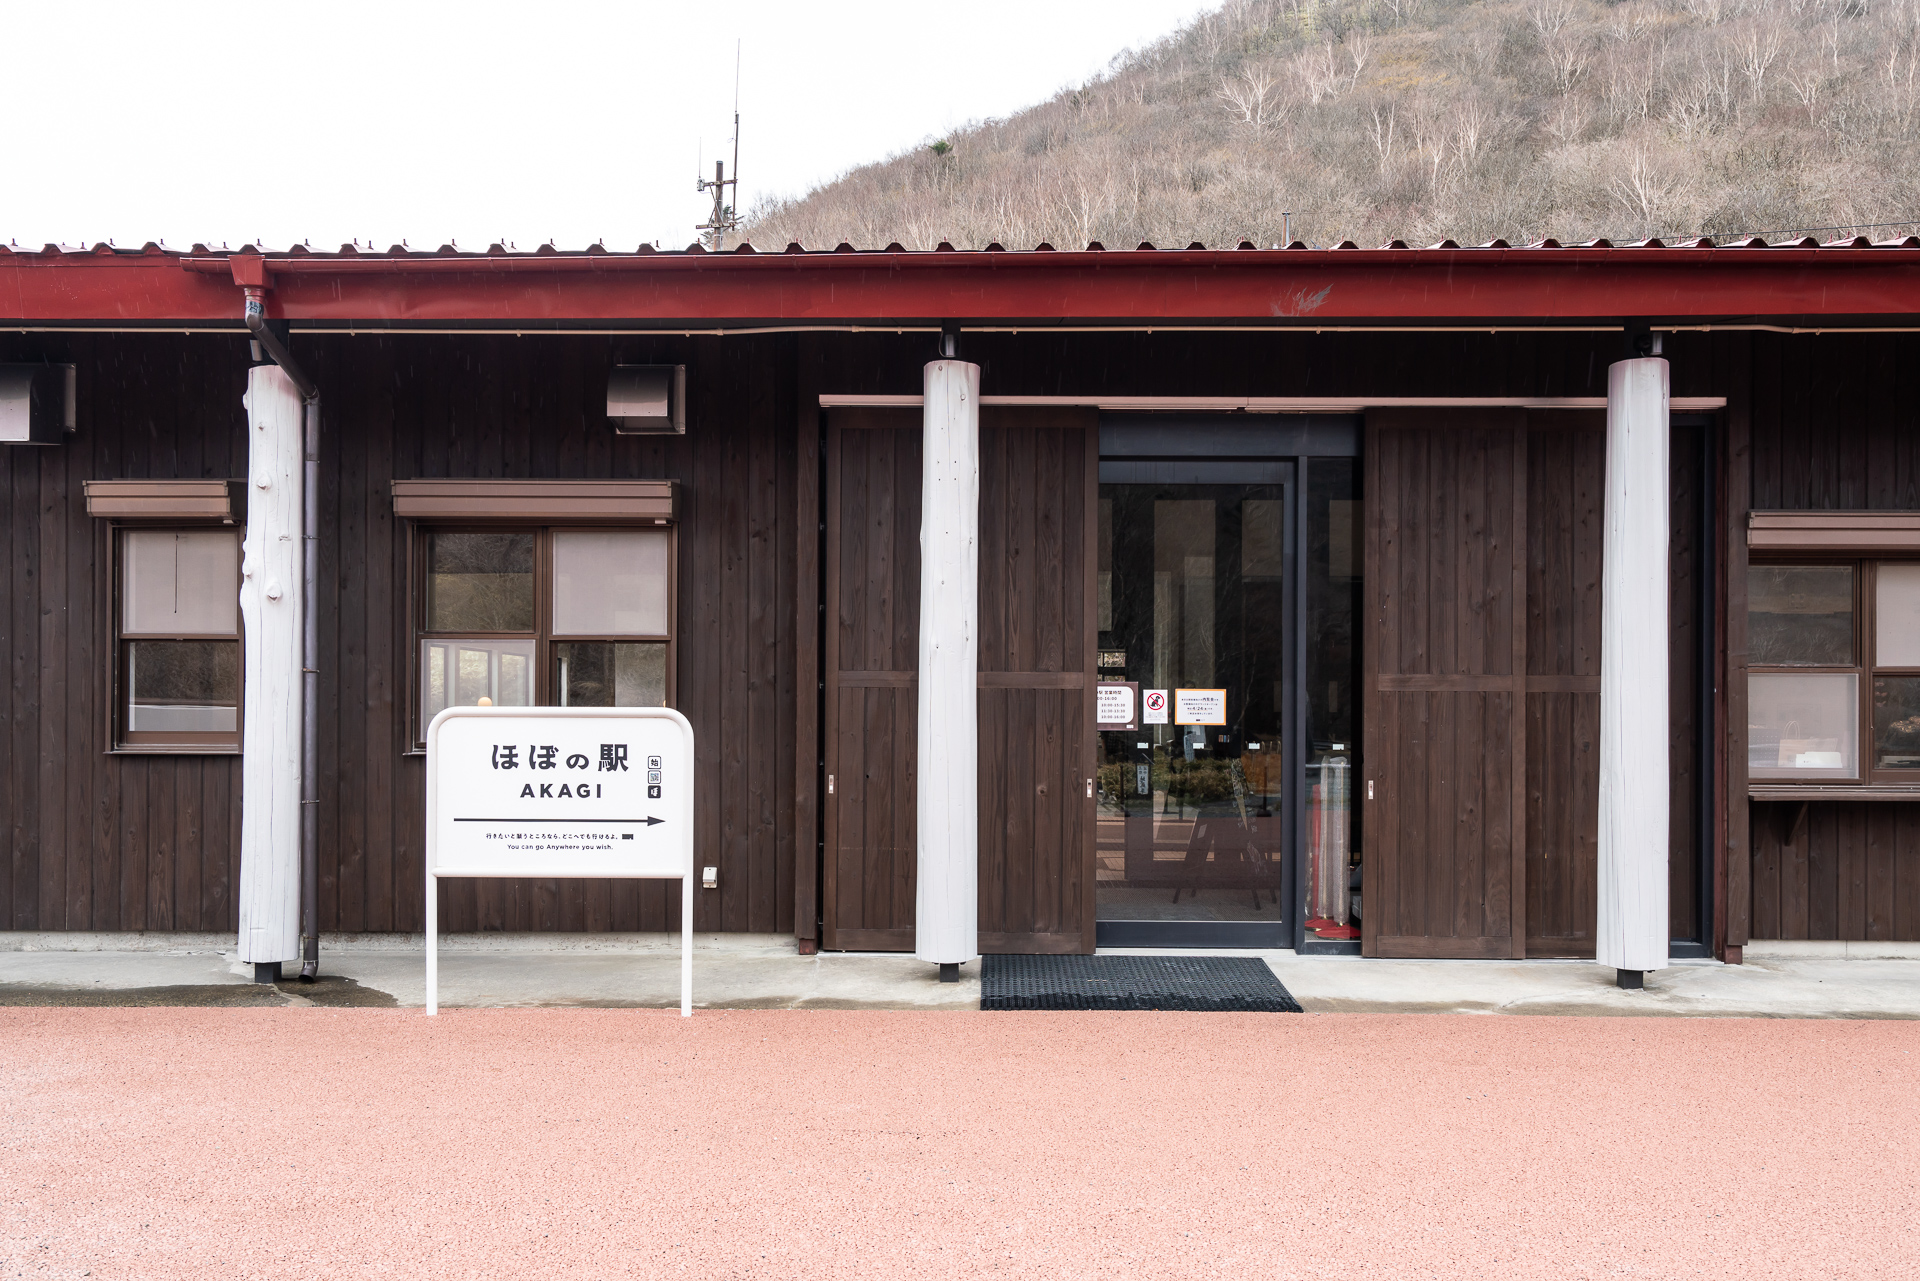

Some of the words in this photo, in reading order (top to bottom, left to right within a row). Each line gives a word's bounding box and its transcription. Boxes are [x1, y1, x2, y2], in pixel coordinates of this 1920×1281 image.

[491, 743, 629, 772] ほぼの駅
[520, 783, 602, 799] AKAGI
